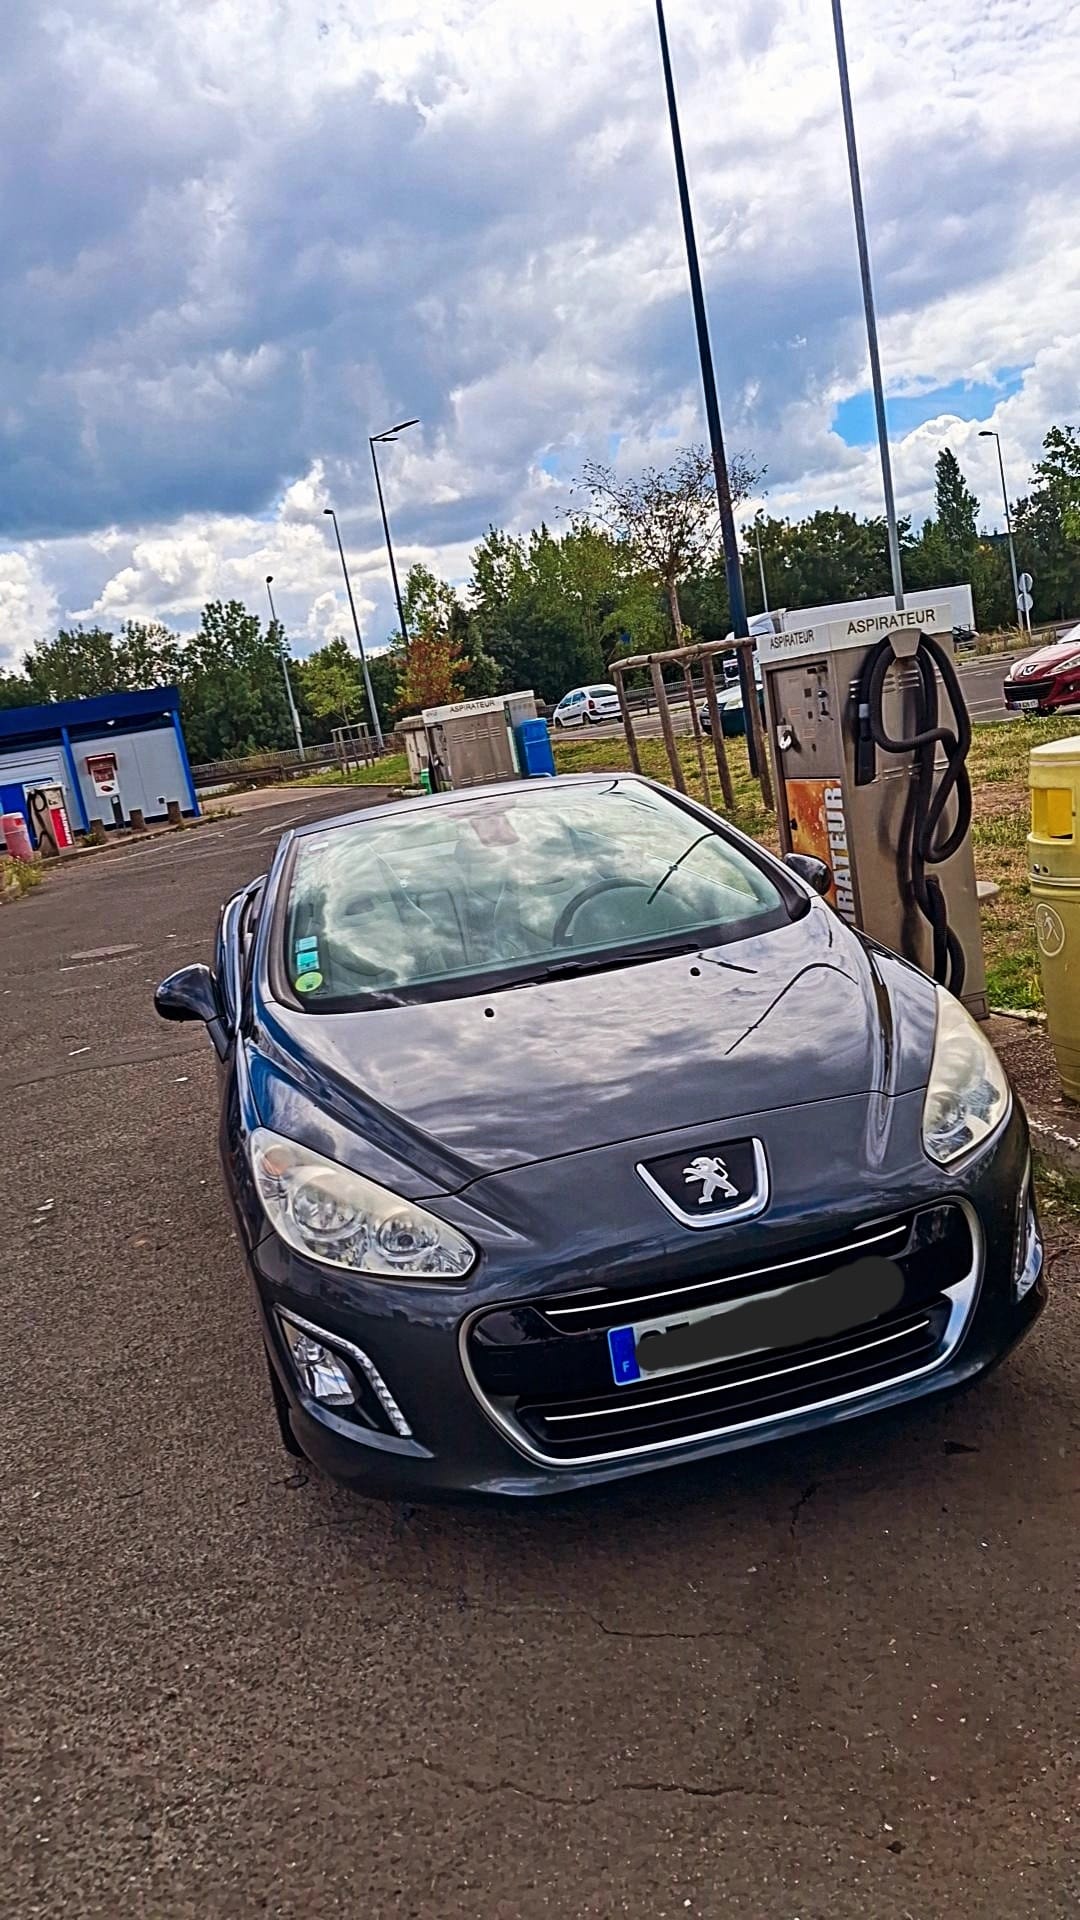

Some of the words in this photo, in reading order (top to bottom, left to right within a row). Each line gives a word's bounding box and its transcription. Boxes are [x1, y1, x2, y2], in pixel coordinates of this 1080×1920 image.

[847, 608, 936, 635] ASPIRATEUR
[770, 629, 815, 650] ASPIRATEUR
[449, 700, 496, 713] ASPIRATEUR
[622, 1360, 630, 1373] F
